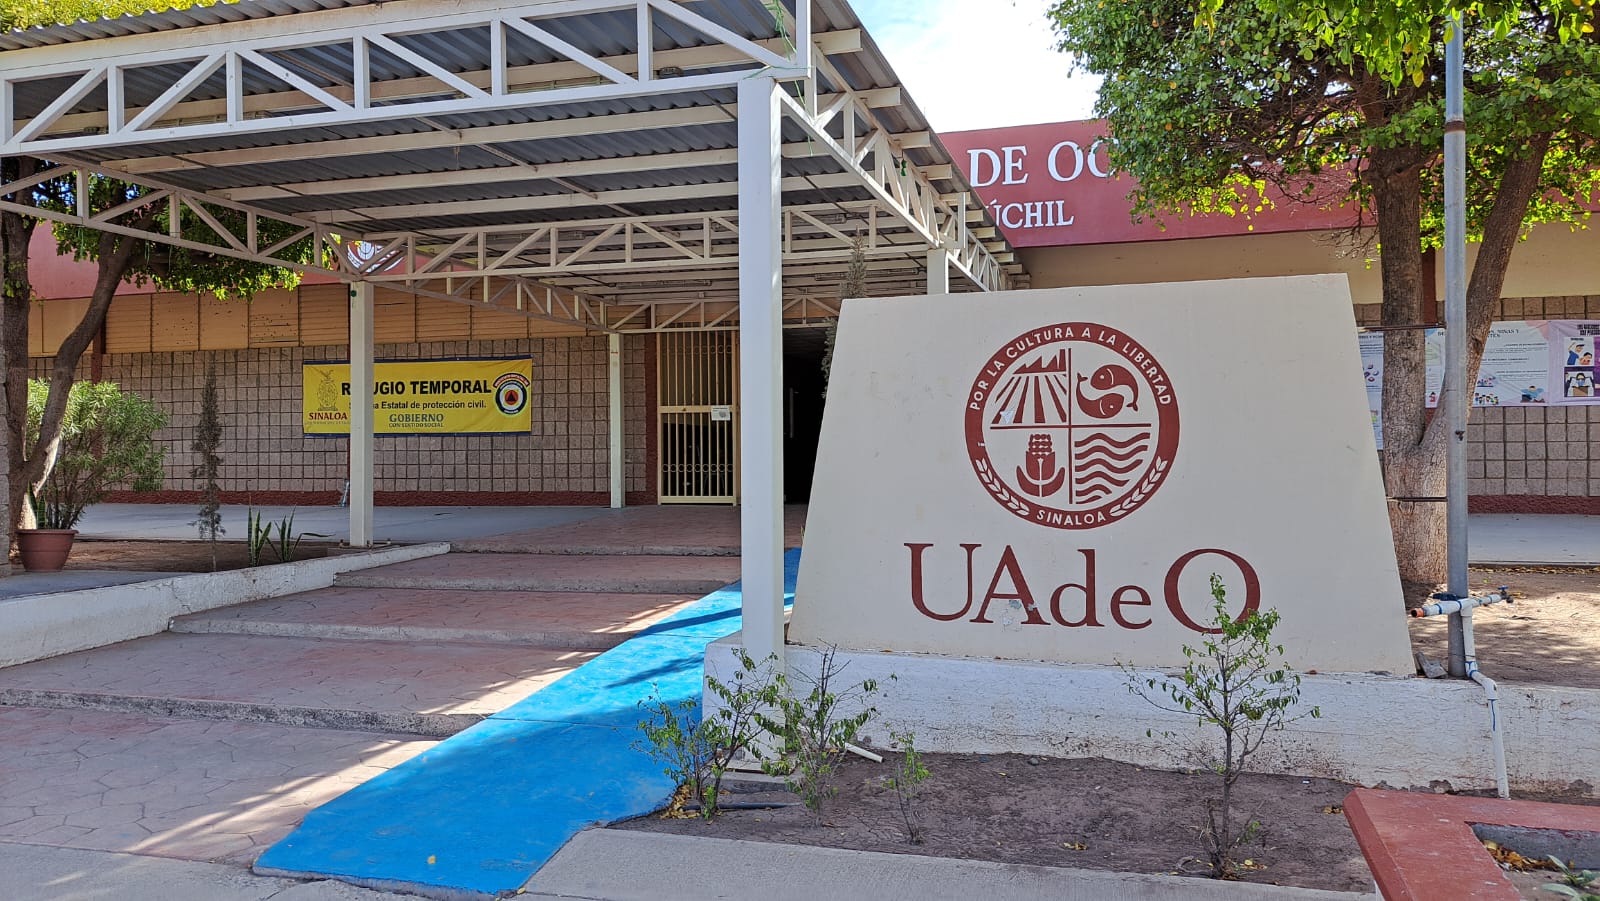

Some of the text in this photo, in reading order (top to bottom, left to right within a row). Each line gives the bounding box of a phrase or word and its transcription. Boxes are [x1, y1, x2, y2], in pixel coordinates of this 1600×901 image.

[967, 137, 1120, 187] DE OC
[970, 327, 1171, 410] POR LA CULTURA A LA LIBERTAD
[341, 381, 406, 396] RUGIO
[410, 380, 492, 395] TEMPORAL
[381, 401, 408, 410] Estatal
[410, 401, 420, 410] de
[422, 400, 465, 410] protección
[308, 412, 348, 420] SINALOA
[389, 413, 444, 422] GOBIERNO
[1036, 510, 1106, 526] SINALOA
[904, 543, 1261, 634] UAdeO
